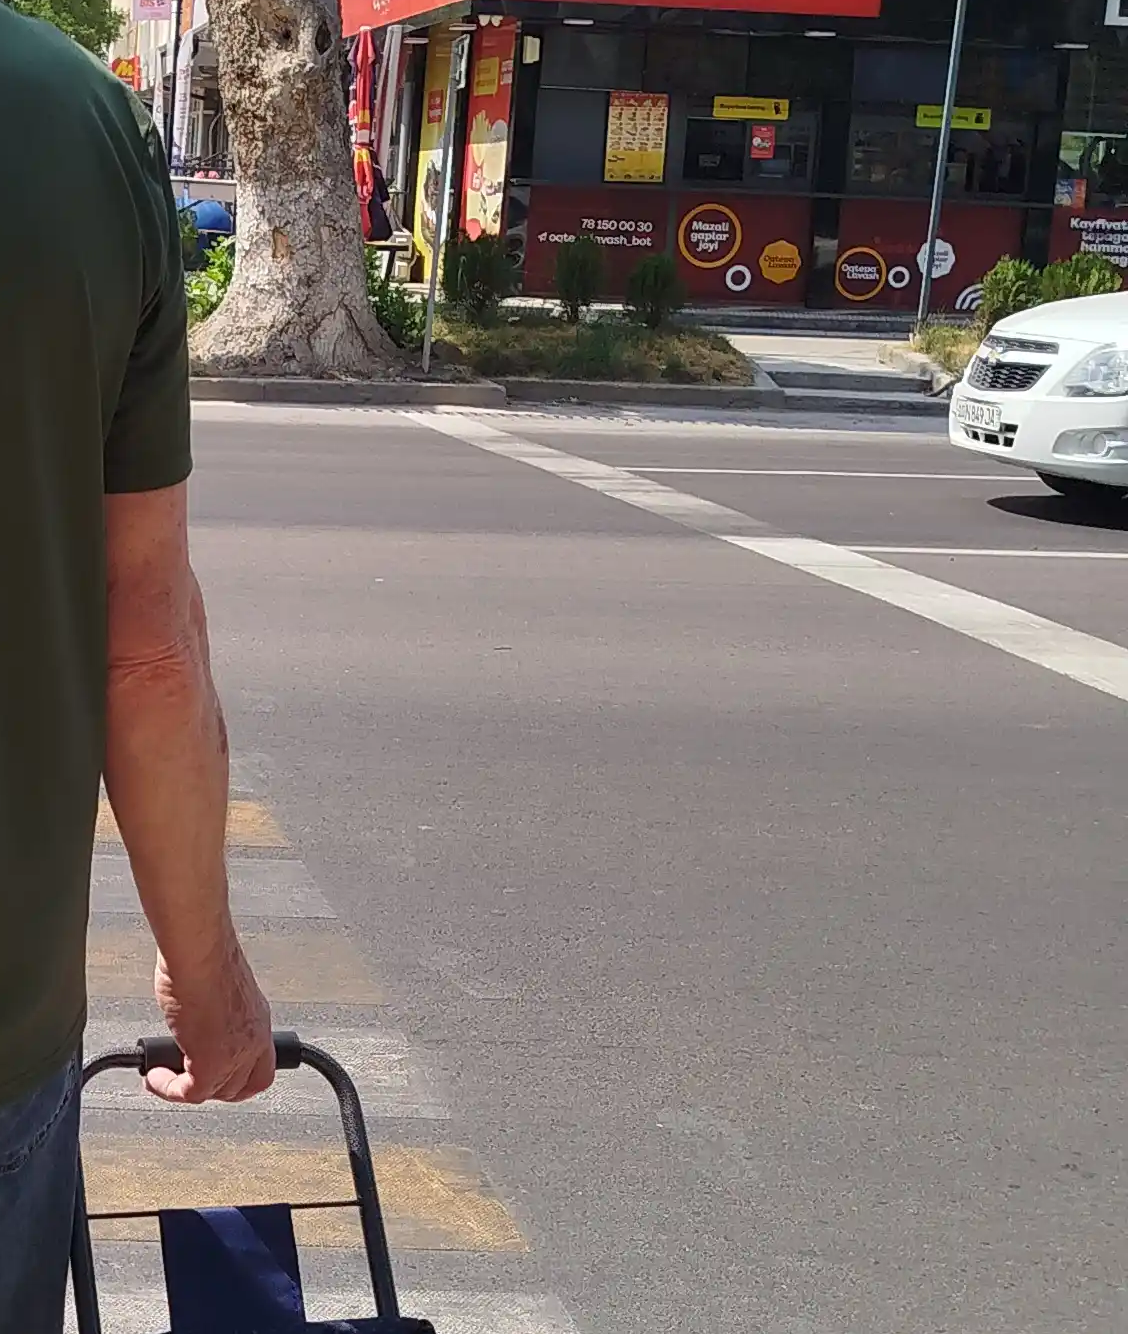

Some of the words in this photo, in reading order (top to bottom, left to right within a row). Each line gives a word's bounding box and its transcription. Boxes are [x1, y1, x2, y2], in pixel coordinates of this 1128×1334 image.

[581, 218, 595, 229] 78
[597, 219, 617, 230] 150
[637, 221, 653, 232] 30
[692, 220, 729, 232] Mazali
[690, 231, 729, 243] gaplar
